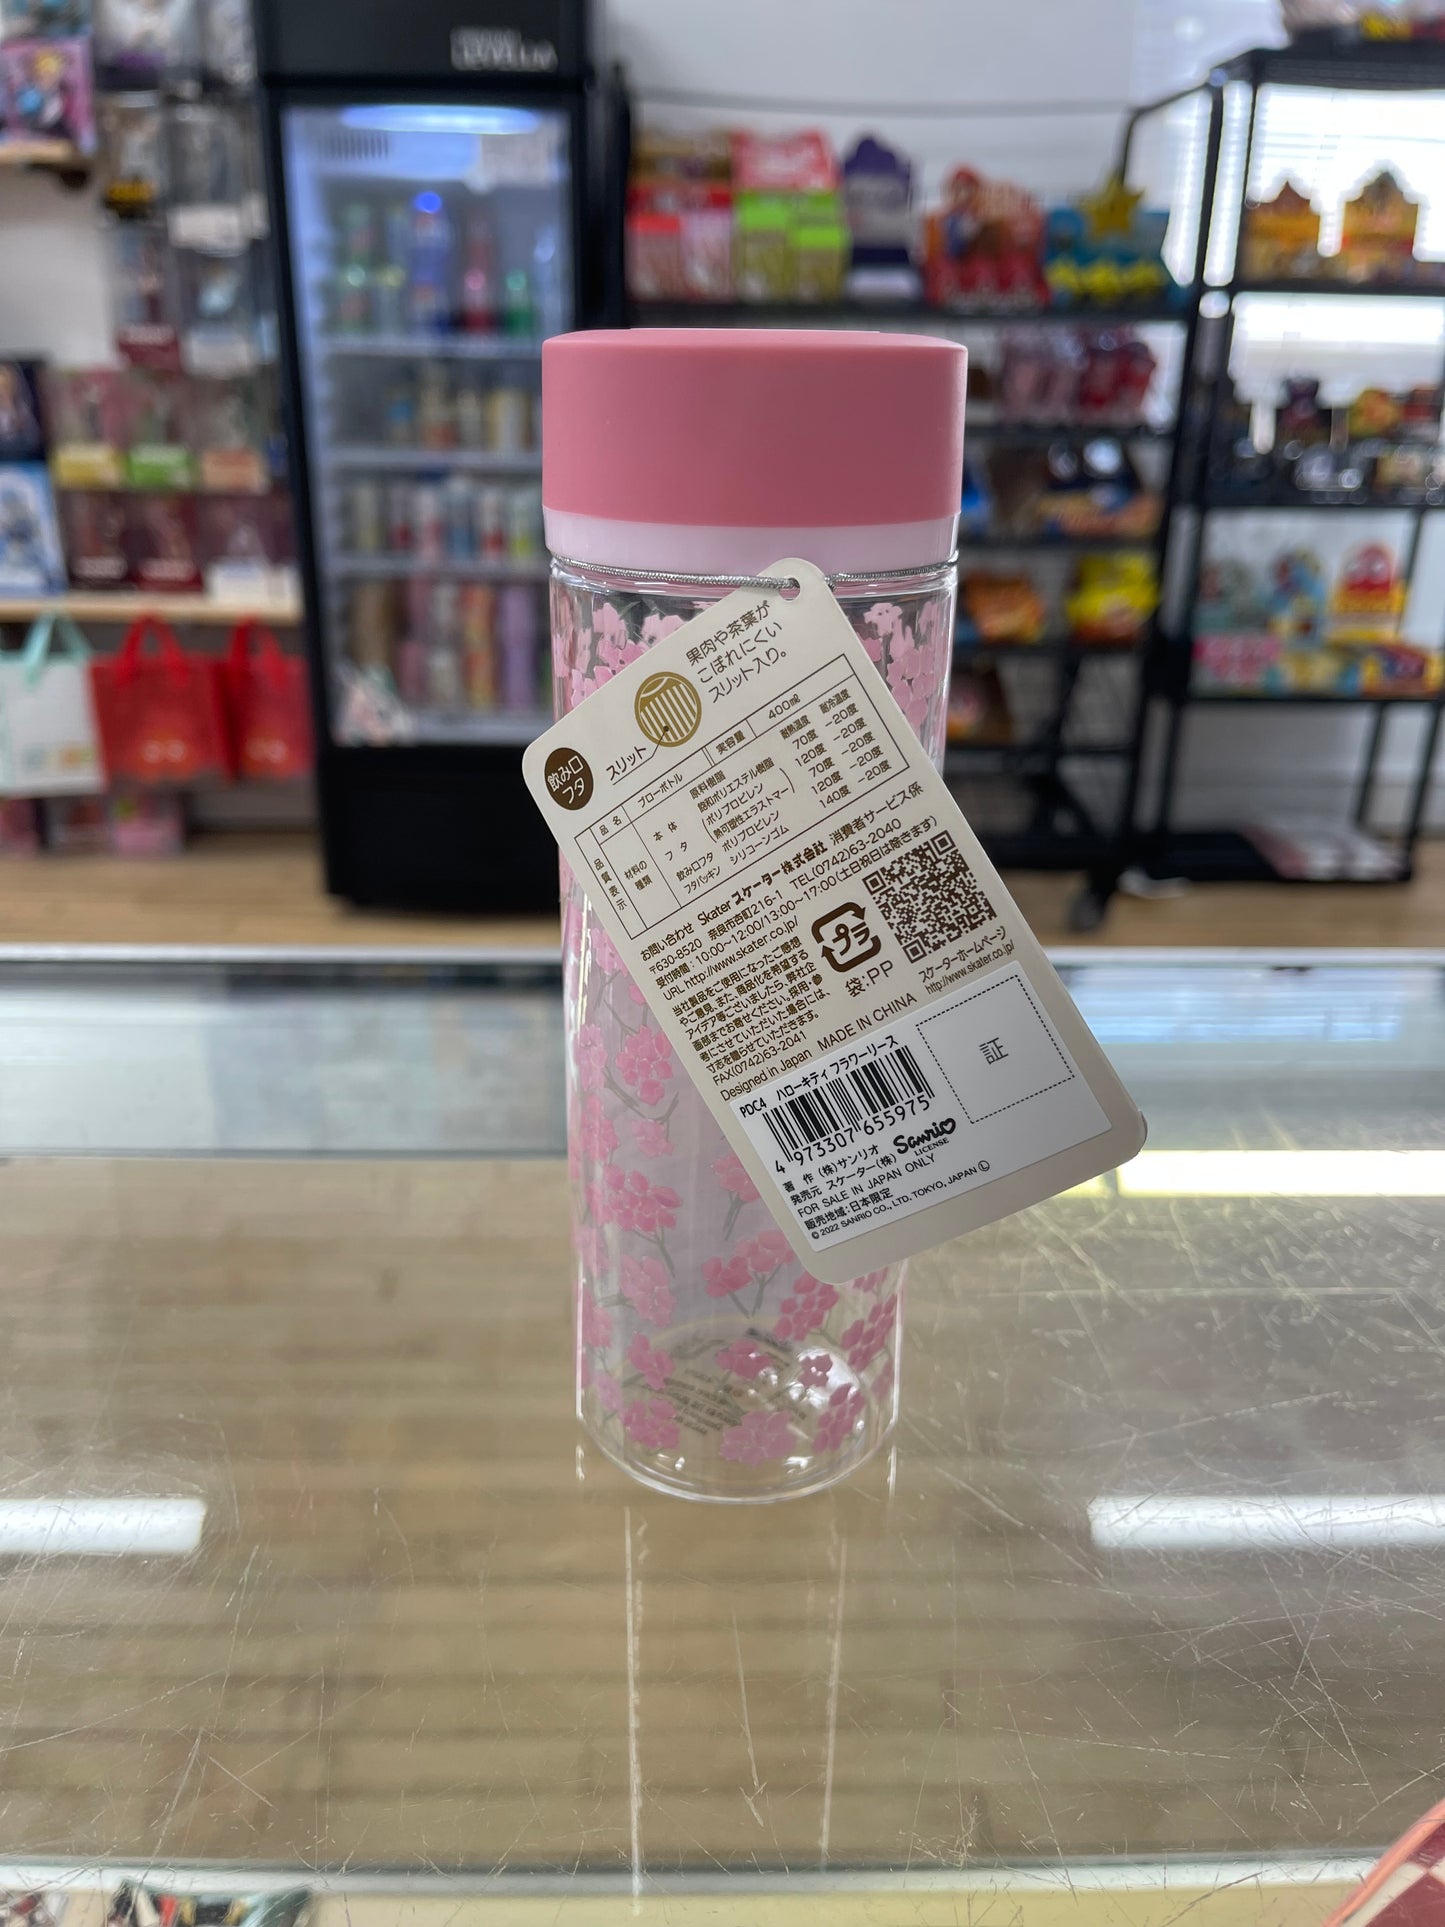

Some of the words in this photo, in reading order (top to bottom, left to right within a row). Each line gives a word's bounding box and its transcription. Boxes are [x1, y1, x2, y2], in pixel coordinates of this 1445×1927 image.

[685, 599, 769, 666] 果肉や茶葉が
[697, 621, 782, 683] こぼれにくい
[708, 647, 786, 703] スリット入り。
[547, 755, 583, 792] 飲み口
[605, 746, 646, 781] スリット
[637, 773, 682, 808] ブローボトル
[715, 729, 745, 755] 実容量
[689, 769, 726, 799] 原料樹脂
[779, 714, 810, 739] 耐熱温度
[818, 688, 851, 714] 耐冷温度
[697, 756, 774, 813] 飽和ポリエステル樹脂
[791, 728, 818, 749] 70度
[561, 777, 584, 804] フタ
[705, 782, 762, 825] ポリプロピレン
[794, 742, 827, 766] 120度
[712, 787, 788, 839] 熱可塑性エラストマー
[807, 756, 835, 777] 70度
[675, 851, 713, 881] 飲み口フタ
[721, 809, 778, 852] ポリプロピレン
[811, 770, 843, 794] 120度
[683, 865, 720, 894] フタパッキン
[729, 824, 789, 865] シリコーンゴム
[818, 784, 851, 808] 140度
[593, 857, 627, 910] 品質表示
[623, 860, 647, 880] 材料の
[634, 874, 652, 890] 種類
[640, 922, 694, 961] お問い合わせ
[697, 900, 731, 925] Skater
[731, 840, 828, 905] スケーター株式会社
[828, 780, 923, 845] 消費者サービス係
[648, 938, 702, 974] 〒630-8520
[707, 889, 782, 941] 奈良市杏町216-1
[789, 818, 901, 889] TEL(0742)63-2040
[662, 984, 685, 1000] URL
[683, 914, 798, 989] http://www.skater.co.jp/
[831, 920, 868, 956] プラ
[918, 925, 1005, 983] スケーターホームページ
[924, 938, 1014, 994] http://www.skater.co.jp/
[671, 935, 802, 1016] 当社製品をご使用になったご感想
[679, 948, 808, 1027] やご意見、また、商品化を希望する
[845, 959, 893, 997] 袋:PP
[712, 1030, 806, 1085] FAX(0742)63-2041
[719, 1069, 768, 1101] Designed
[766, 1066, 779, 1077] in
[780, 1049, 812, 1071] Japan
[816, 1023, 856, 1051] MADE
[855, 1014, 872, 1030] IN
[872, 992, 917, 1021] CHINA
[739, 1097, 767, 1117] PDC4
[776, 1068, 828, 1101] ハローキティ
[829, 1034, 898, 1074] フラワーリース
[979, 1037, 1008, 1064] 証
[775, 1160, 785, 1173] 4
[793, 1127, 854, 1166] 973307
[863, 1094, 929, 1135] 655975
[818, 1144, 878, 1177] (株)サンリオ
[892, 1117, 956, 1154] Sanrio
[913, 1137, 949, 1156] LICENSE
[789, 1185, 822, 1205] 発売元
[825, 1152, 896, 1190] スケーター(株)
[797, 1202, 820, 1217] FOR
[821, 1189, 849, 1207] SALE
[850, 1183, 863, 1195] IN
[867, 1167, 902, 1189] JAPAN
[904, 1152, 934, 1172] ONLY
[803, 1187, 893, 1230] 販売地域:日本限定
[819, 1223, 840, 1235] 2022
[840, 1209, 872, 1227] SANRIO
[872, 1204, 892, 1214] CO.,
[891, 1195, 912, 1206] LTD.
[911, 1180, 946, 1198] TOKYO,
[947, 1166, 977, 1184] JAPAN
